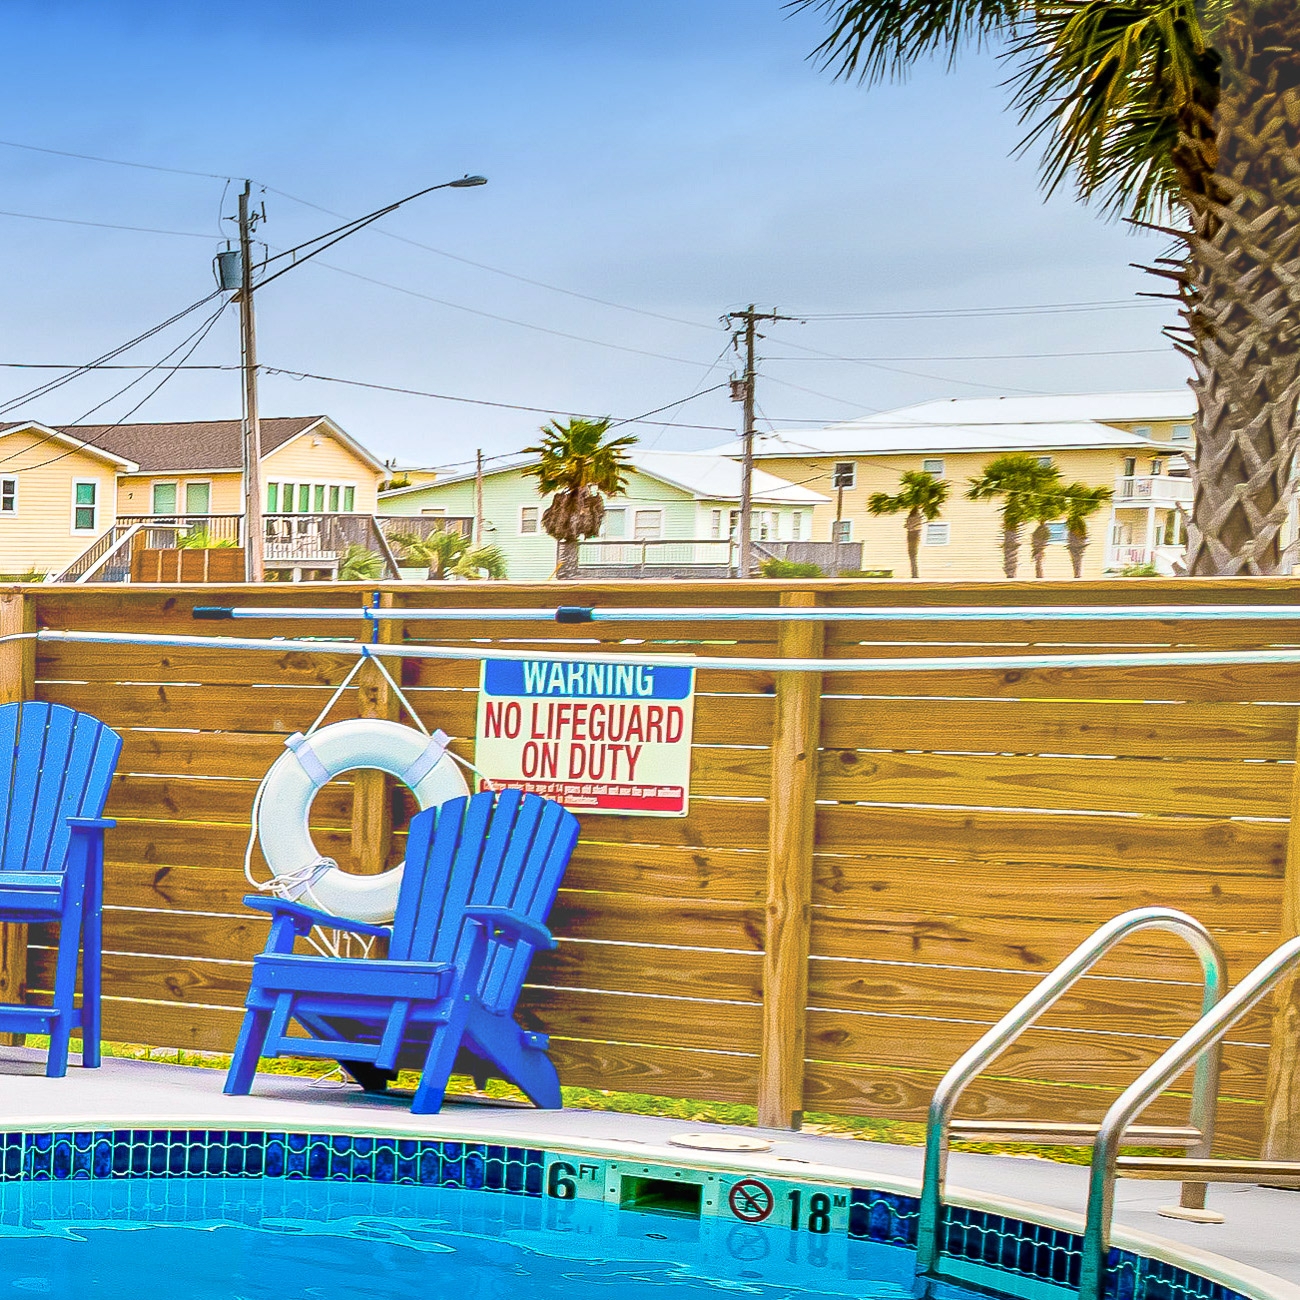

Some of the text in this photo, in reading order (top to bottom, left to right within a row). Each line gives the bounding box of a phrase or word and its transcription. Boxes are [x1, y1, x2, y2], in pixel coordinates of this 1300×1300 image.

[523, 662, 654, 696] WARNING
[484, 702, 684, 743] NO LIFEGUARD
[521, 741, 643, 782] ON DUTY
[548, 1162, 599, 1200] 6 FT
[833, 1194, 847, 1208] M
